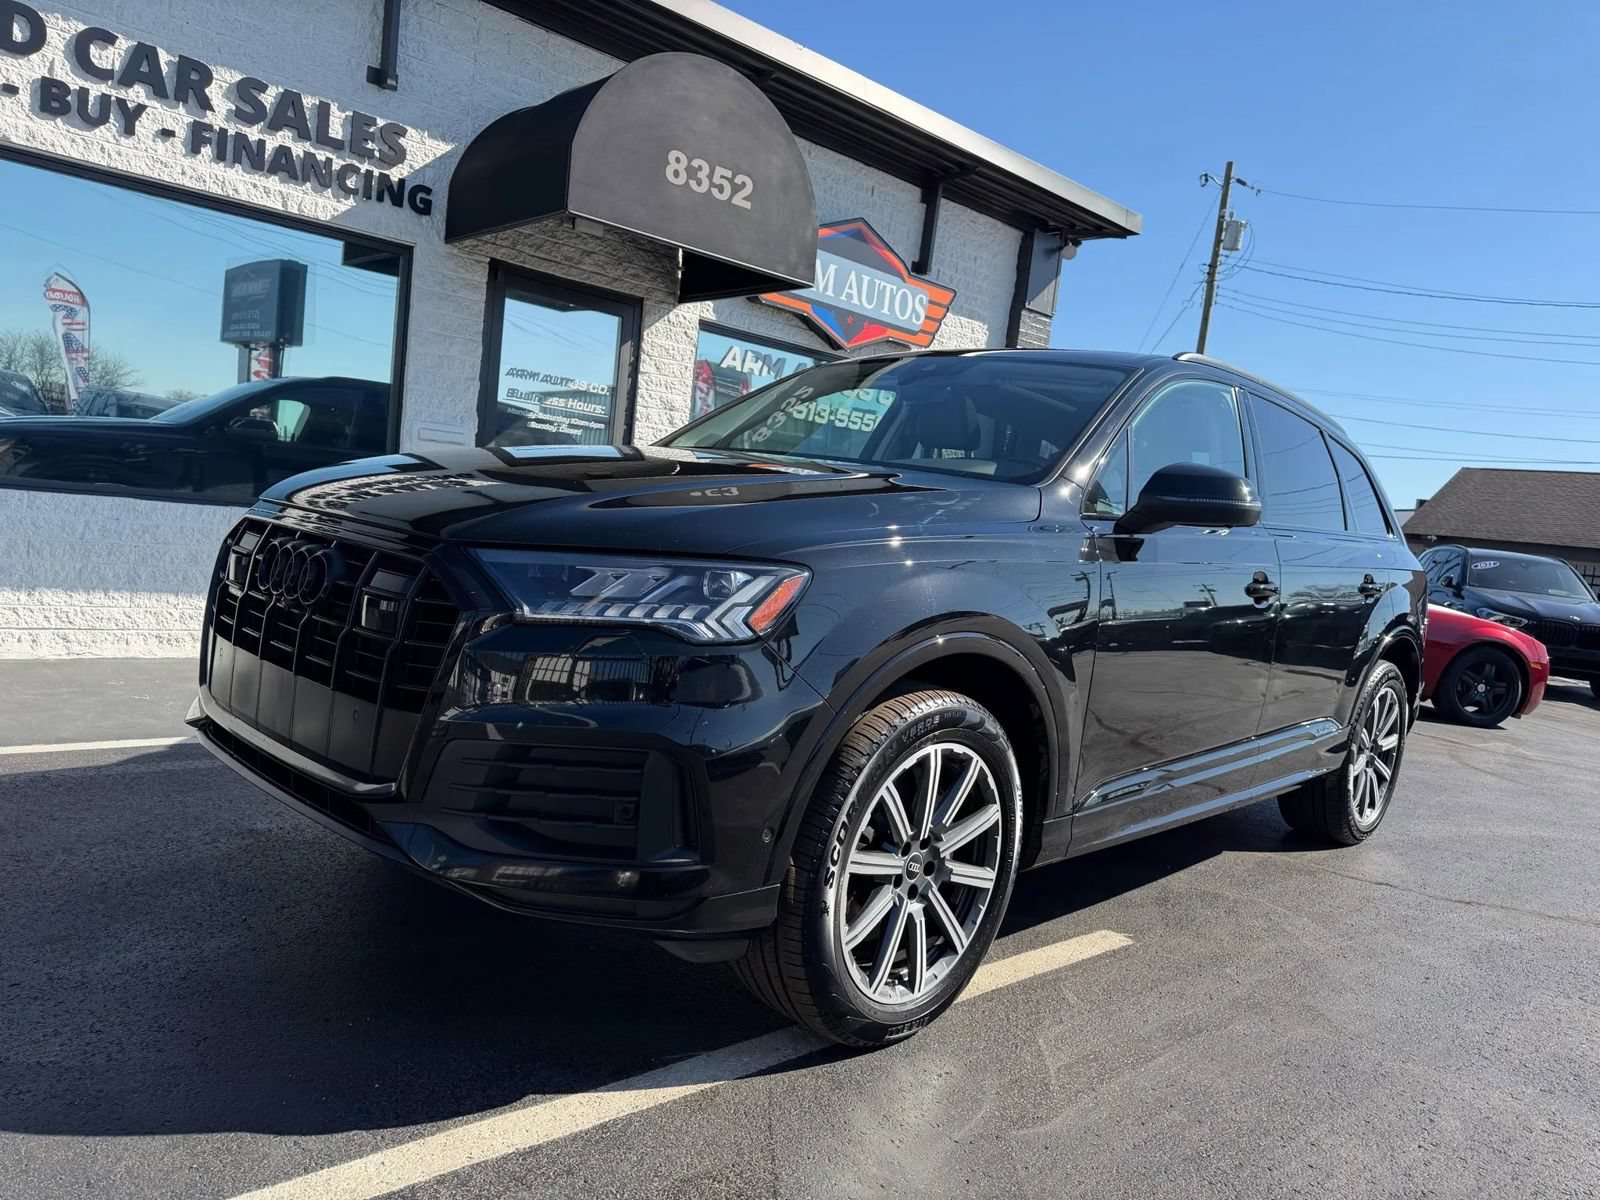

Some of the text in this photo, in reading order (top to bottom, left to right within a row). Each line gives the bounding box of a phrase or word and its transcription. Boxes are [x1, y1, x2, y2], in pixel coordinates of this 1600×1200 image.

[74, 27, 215, 112] CAR
[234, 76, 408, 167] SALES
[39, 75, 149, 136] BUY
[191, 119, 433, 216] FINANCING
[665, 149, 754, 210] 8352
[840, 268, 928, 326] AUTOS
[566, 397, 607, 415] Hours:
[901, 714, 941, 743] VERDE
